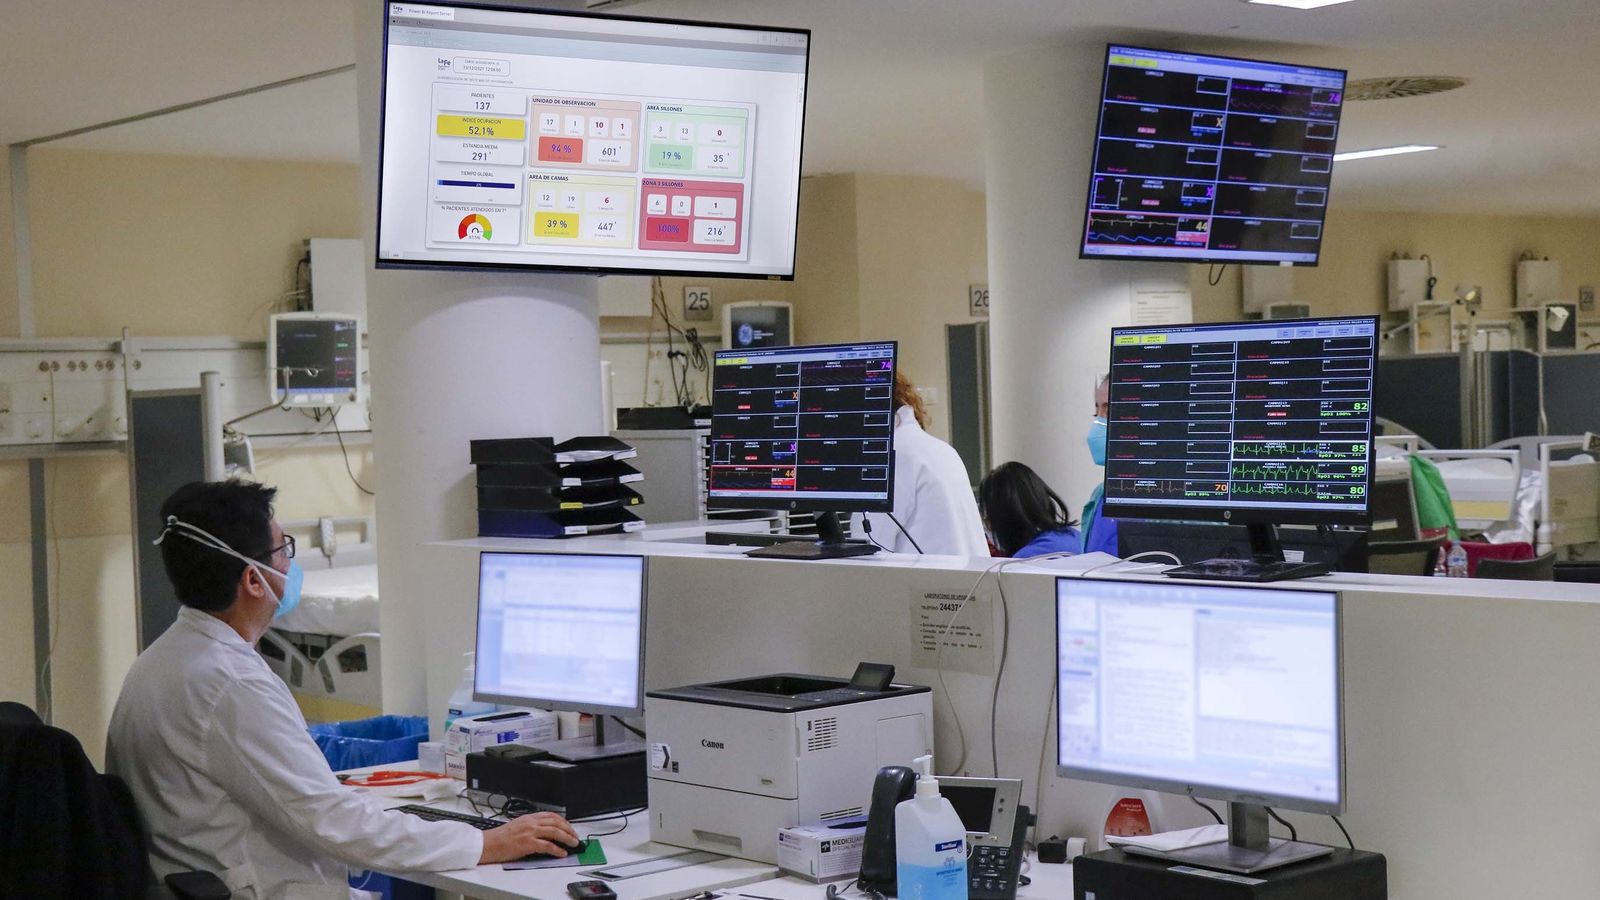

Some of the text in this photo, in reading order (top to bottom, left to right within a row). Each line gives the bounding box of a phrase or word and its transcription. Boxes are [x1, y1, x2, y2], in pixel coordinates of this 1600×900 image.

[475, 102, 490, 110] 137
[468, 126, 494, 136] 52,1%
[551, 144, 571, 153] 94 %
[662, 152, 672, 160] 19
[547, 220, 557, 228] 39
[658, 224, 679, 232] 100%
[1196, 222, 1207, 231] 44
[688, 292, 709, 310] 25
[974, 290, 989, 307] 26
[702, 739, 724, 749] Canon
[811, 860, 816, 876] L
